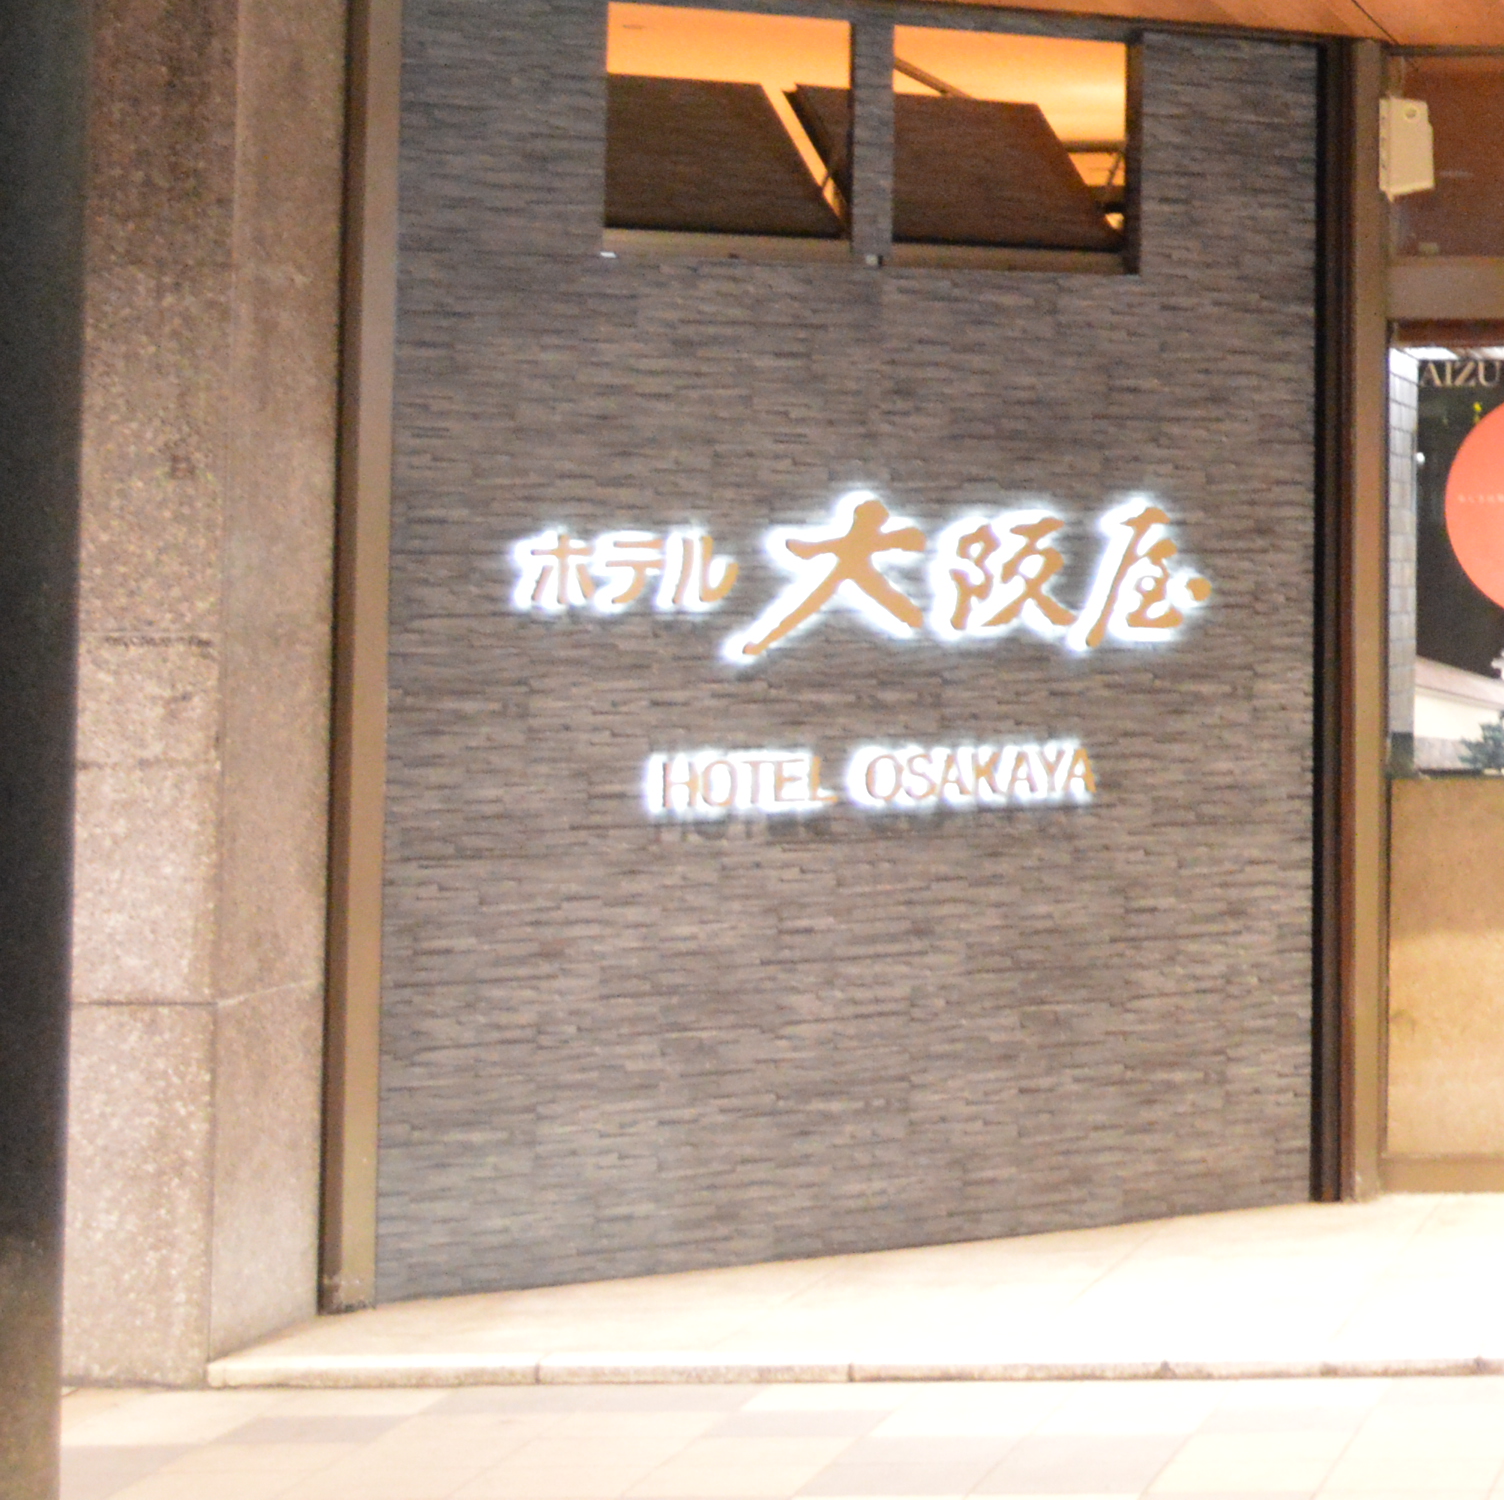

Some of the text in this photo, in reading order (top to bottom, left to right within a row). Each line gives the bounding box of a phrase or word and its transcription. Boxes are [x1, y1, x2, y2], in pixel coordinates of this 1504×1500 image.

[1419, 361, 1500, 387] AIZU
[514, 496, 1213, 657] ホテル 大阪屋
[655, 742, 1097, 813] HOTEL OSAKAYA
